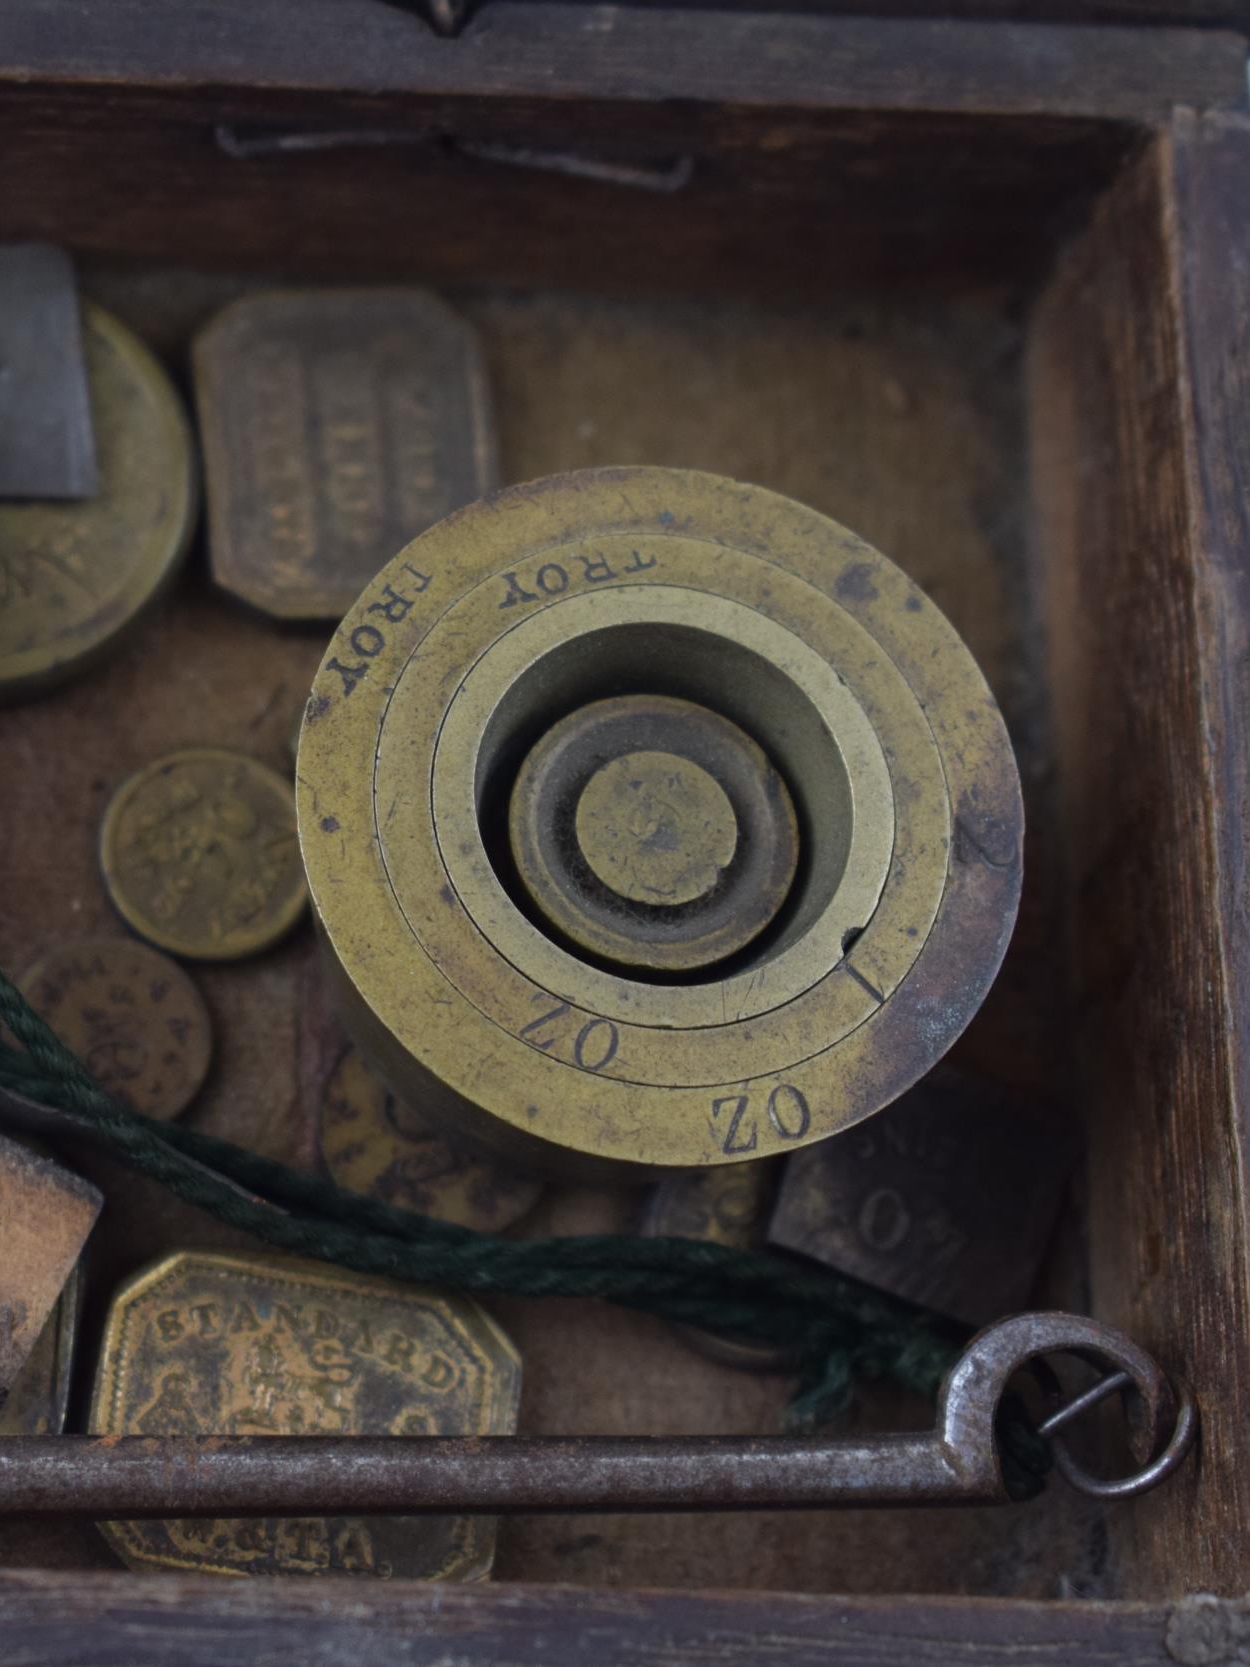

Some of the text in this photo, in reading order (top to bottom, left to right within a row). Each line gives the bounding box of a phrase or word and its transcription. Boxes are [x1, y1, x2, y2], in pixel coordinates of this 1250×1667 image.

[498, 548, 657, 610] TROY
[324, 561, 434, 698] TROY
[518, 990, 620, 1073] OZ
[711, 1083, 812, 1155] OZ
